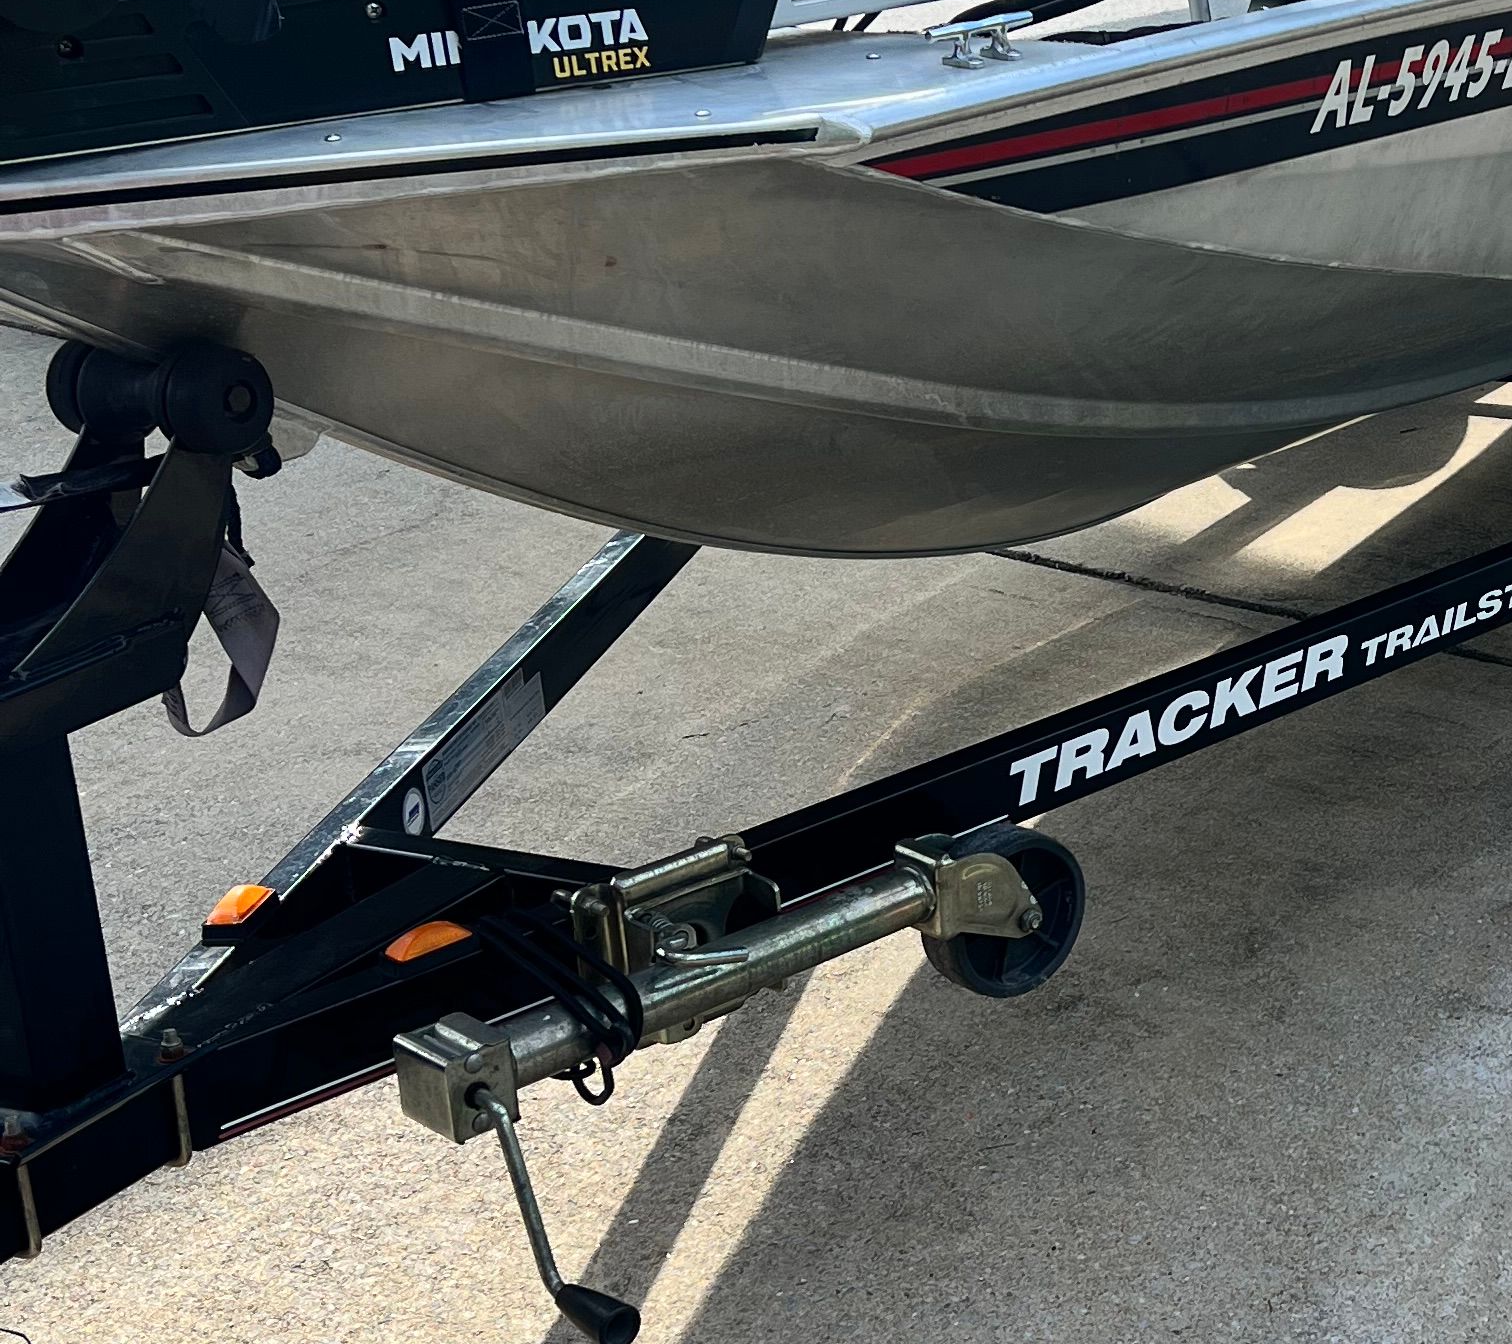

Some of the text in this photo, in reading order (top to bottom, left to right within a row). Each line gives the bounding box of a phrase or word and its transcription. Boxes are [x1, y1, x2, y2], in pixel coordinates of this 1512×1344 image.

[527, 8, 649, 55] KOTA
[552, 46, 652, 78] ULTREX
[1009, 634, 1349, 807] TRACKER
